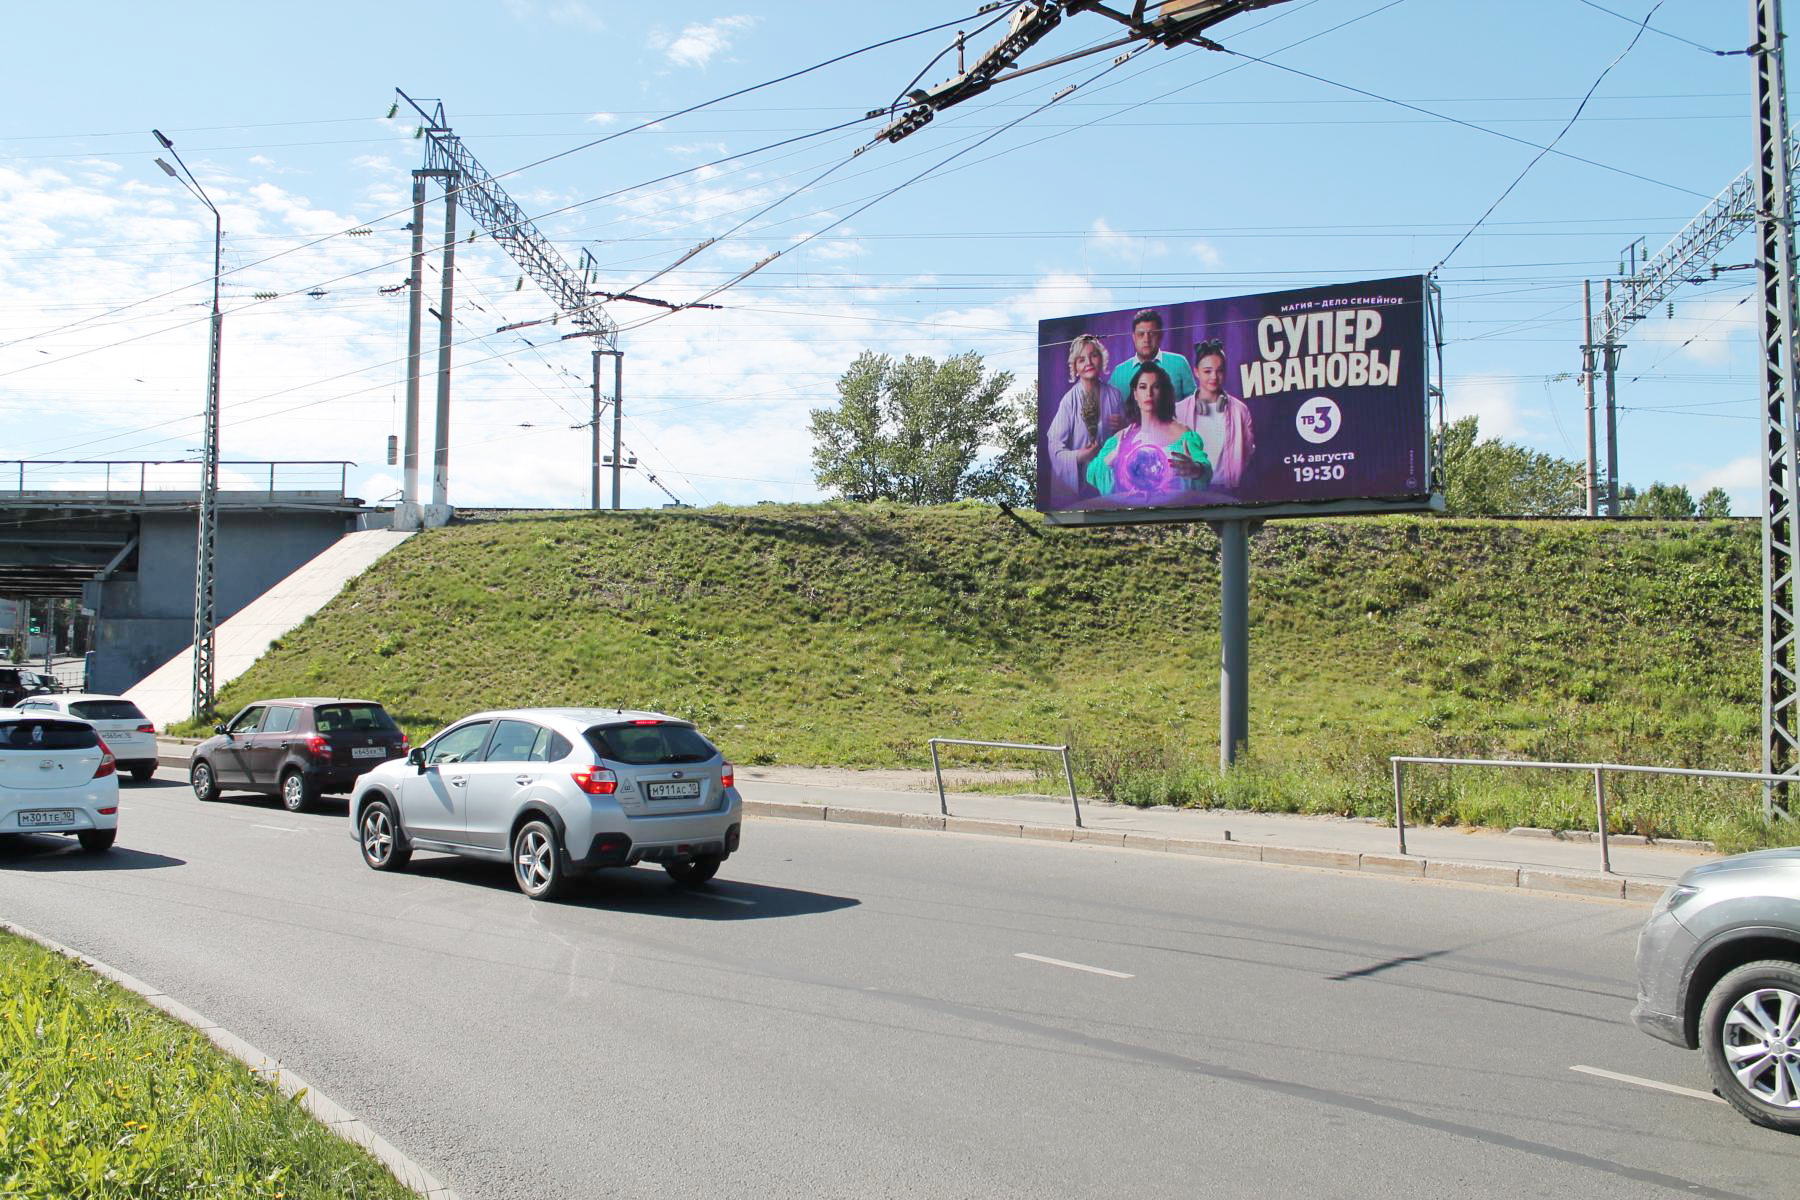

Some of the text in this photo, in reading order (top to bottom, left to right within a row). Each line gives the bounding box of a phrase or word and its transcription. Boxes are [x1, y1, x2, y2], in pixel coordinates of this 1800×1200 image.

[1281, 302, 1313, 312] МАГИЯ
[1350, 295, 1404, 305] СЕМЕЙНОЕ
[1257, 309, 1383, 362] СУПЕР
[1239, 349, 1401, 399] ИВАНОВЫ
[1292, 453, 1305, 464] 14
[1307, 451, 1355, 465] августа
[1293, 464, 1345, 483] 19:30
